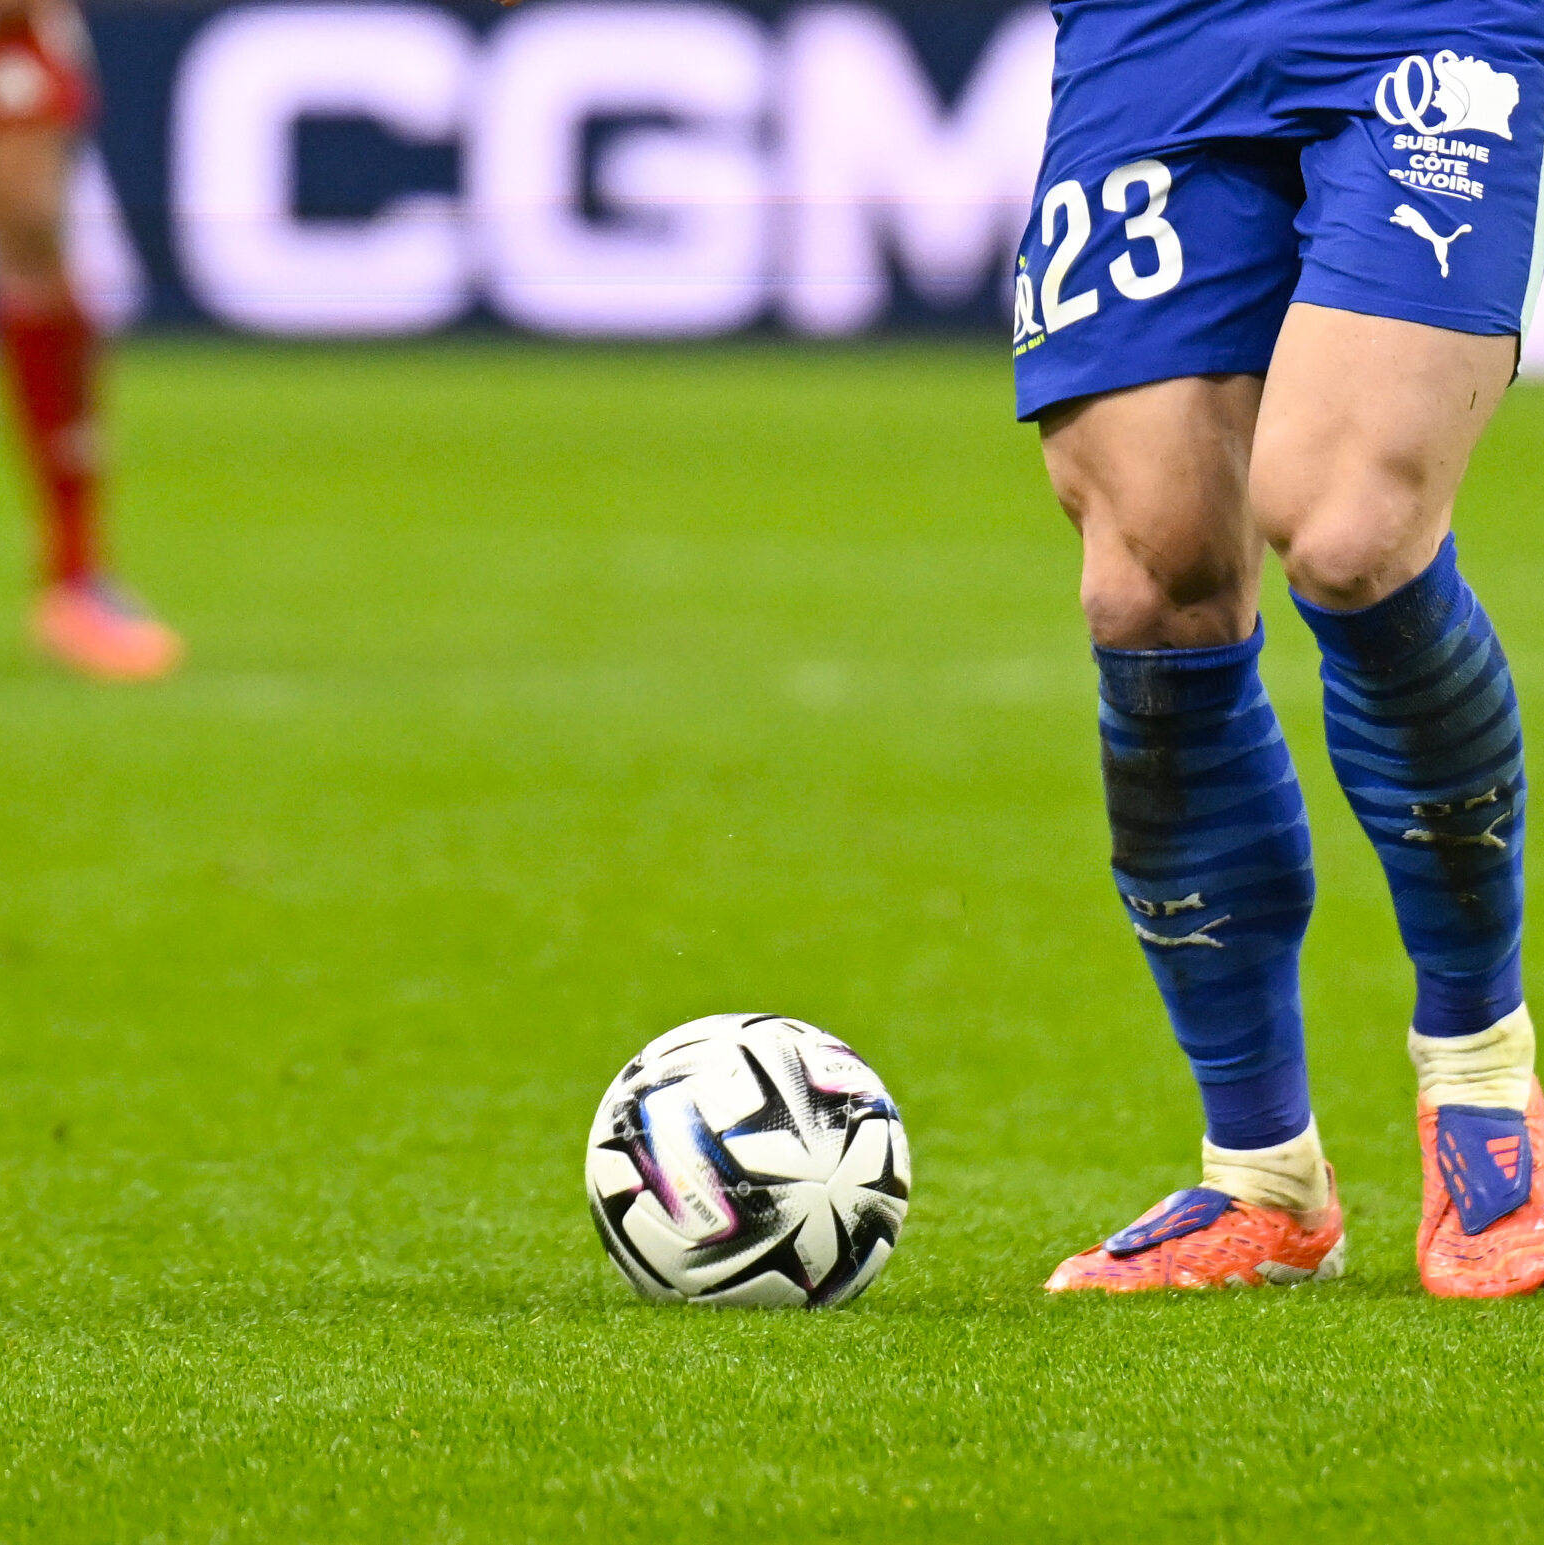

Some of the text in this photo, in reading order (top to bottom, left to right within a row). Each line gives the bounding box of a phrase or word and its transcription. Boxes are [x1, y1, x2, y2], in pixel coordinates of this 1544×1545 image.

[1392, 133, 1490, 164] SUBLIME
[1408, 152, 1469, 176] CÔTE
[1388, 168, 1485, 200] D'IVOIRE
[1040, 158, 1184, 335] 23
